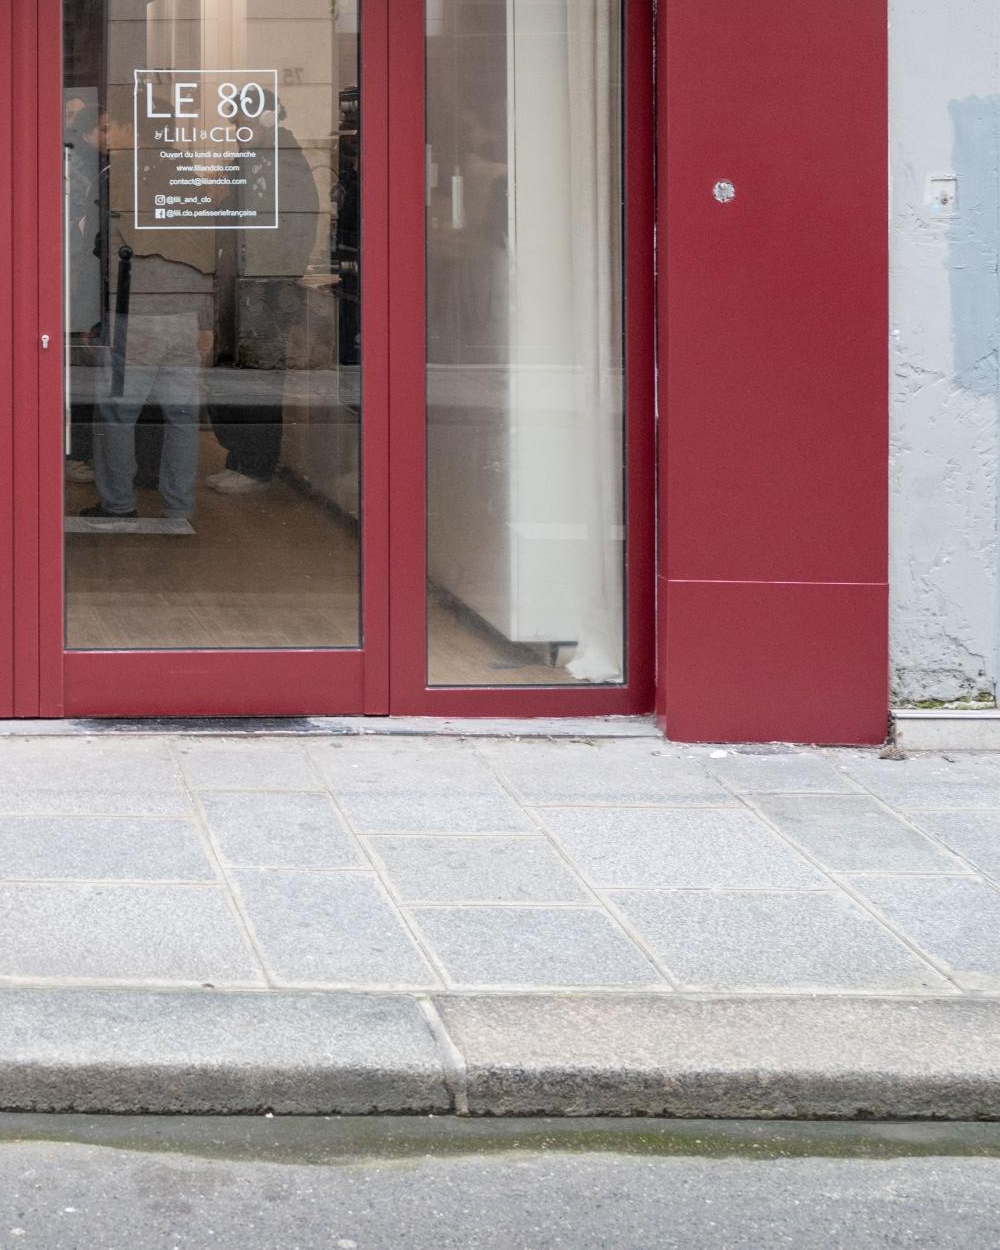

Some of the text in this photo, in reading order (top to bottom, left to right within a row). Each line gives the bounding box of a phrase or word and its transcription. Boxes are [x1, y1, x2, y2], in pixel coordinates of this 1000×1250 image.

[146, 82, 265, 118] LE 80
[154, 126, 254, 142] by LILI & CLO
[169, 178, 247, 186] contact@liliandclo.com
[166, 196, 212, 205] @lili_and_clo
